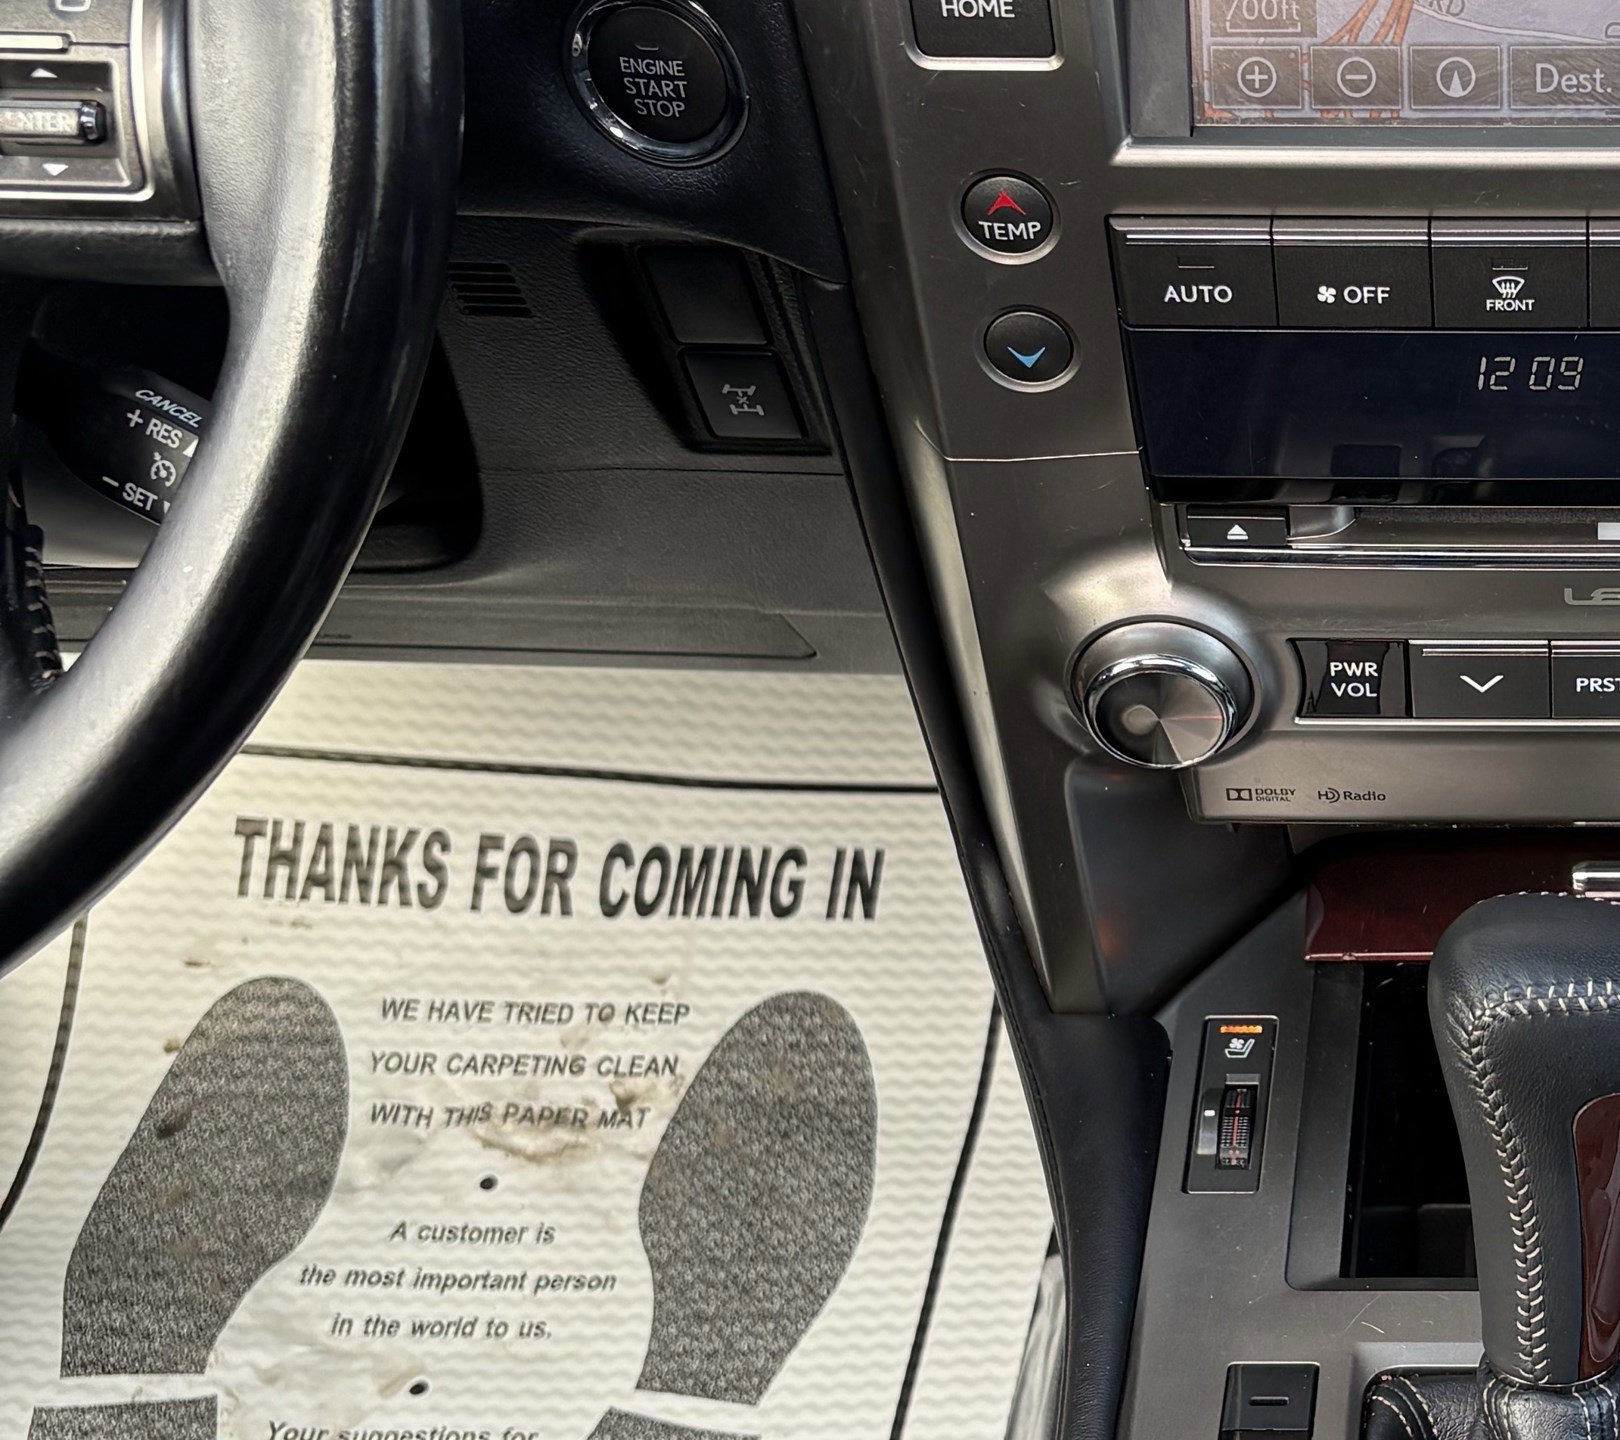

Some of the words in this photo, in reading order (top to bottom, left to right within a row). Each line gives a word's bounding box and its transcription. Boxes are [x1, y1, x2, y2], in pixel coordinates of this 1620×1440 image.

[619, 57, 685, 77] ENGINE
[1535, 63, 1613, 94] Dest.
[623, 77, 688, 98] START
[634, 98, 686, 118] STOP
[978, 220, 1041, 242] TEMP
[1163, 285, 1233, 304] AUTO
[1343, 285, 1390, 304] OFF
[1485, 298, 1535, 313] FRONT
[135, 389, 203, 428] CANCEL
[145, 418, 183, 449] RES
[122, 482, 158, 511] SET
[1330, 662, 1379, 678] PWR
[1331, 682, 1378, 698] VOL
[1255, 788, 1297, 796] DOLBY
[1343, 790, 1386, 801] Radio
[234, 816, 452, 909] THANKS
[470, 831, 578, 915] FOR
[599, 840, 807, 919] COMING
[825, 846, 886, 921] IN
[381, 997, 420, 1023] WE
[427, 999, 495, 1024] HAVE
[504, 1001, 574, 1026] TRIED
[585, 1002, 616, 1024] TO
[625, 1001, 691, 1025] KEEP
[369, 1050, 437, 1075] YOUR
[446, 1052, 587, 1077] CARPETING
[596, 1054, 680, 1078] CLEAN
[369, 1102, 434, 1128] WITH
[443, 1101, 493, 1128] THIS
[502, 1102, 589, 1129] PAPER
[598, 1107, 651, 1129] MAT
[388, 1219, 407, 1242] A
[417, 1222, 528, 1245] customer
[536, 1222, 556, 1245] is
[299, 1264, 337, 1287] the
[344, 1267, 405, 1288] most
[412, 1267, 528, 1294] important
[533, 1272, 618, 1296] person
[330, 1312, 354, 1337] in
[363, 1314, 401, 1338] the
[411, 1316, 479, 1339] world
[486, 1318, 508, 1339] to
